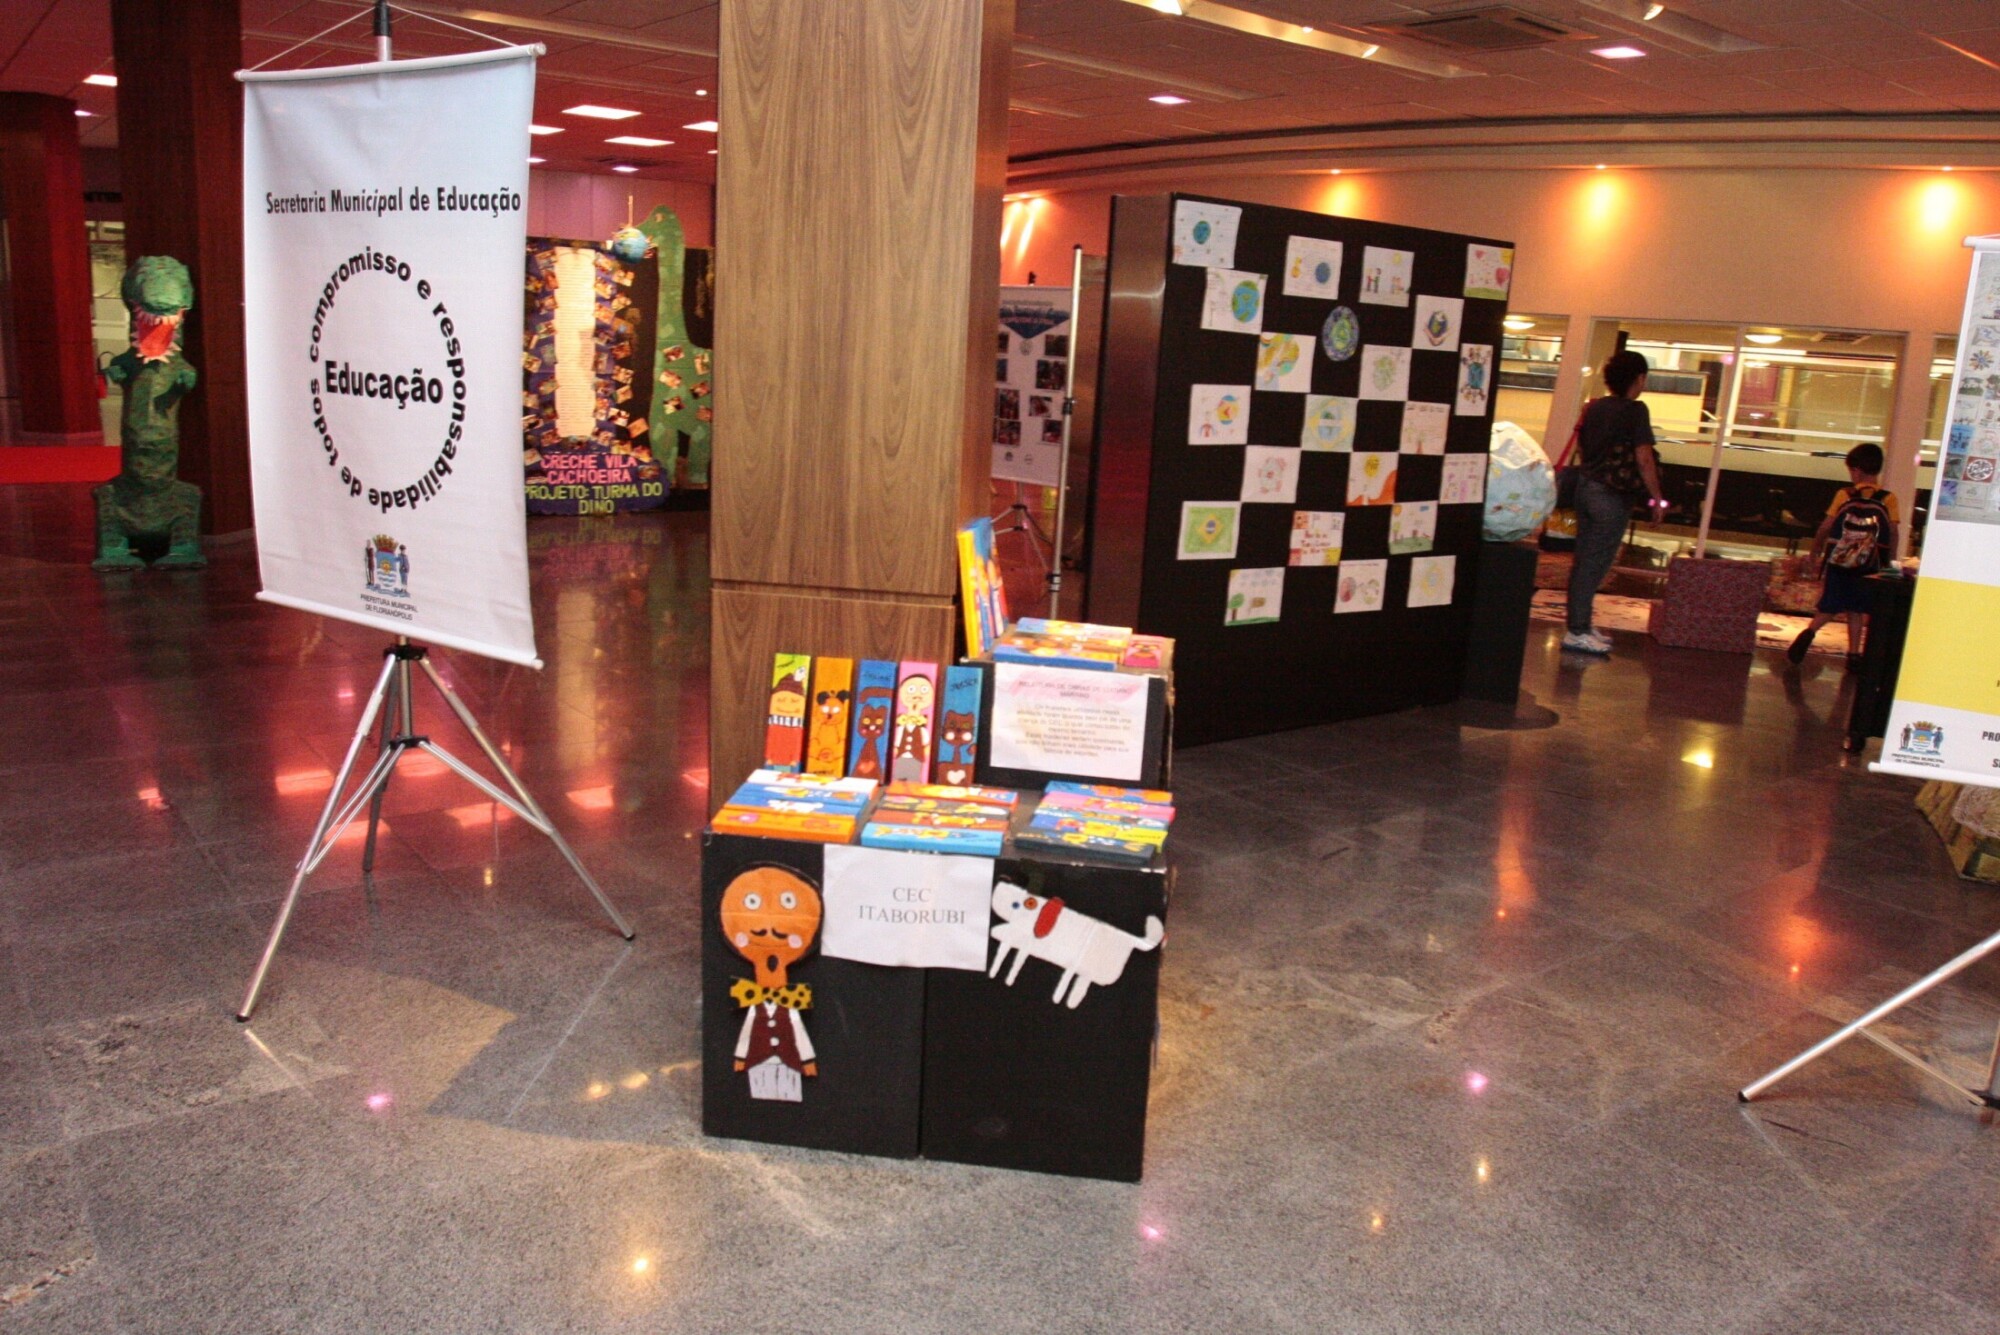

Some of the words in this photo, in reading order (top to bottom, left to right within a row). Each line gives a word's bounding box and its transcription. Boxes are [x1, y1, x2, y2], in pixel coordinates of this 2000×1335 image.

[266, 191, 326, 214] Secretaria
[331, 186, 403, 217] Municipal
[409, 186, 431, 213] de
[437, 186, 521, 218] Educação
[417, 279, 432, 300] e
[309, 246, 411, 363] compromisso
[325, 360, 444, 410] Educação
[368, 302, 467, 514] responsabilidade
[311, 378, 338, 466] todos
[541, 454, 597, 469] CRECHE
[605, 454, 638, 469] VILA
[341, 466, 363, 497] de
[547, 468, 632, 485] CACHOEIRA
[591, 483, 640, 499] TURMA
[642, 481, 663, 497] DO
[361, 594, 390, 606] PREFEITURA
[391, 601, 418, 613] MUNICIPAL
[892, 887, 932, 903] CEC
[858, 904, 966, 925] ITABORUBI
